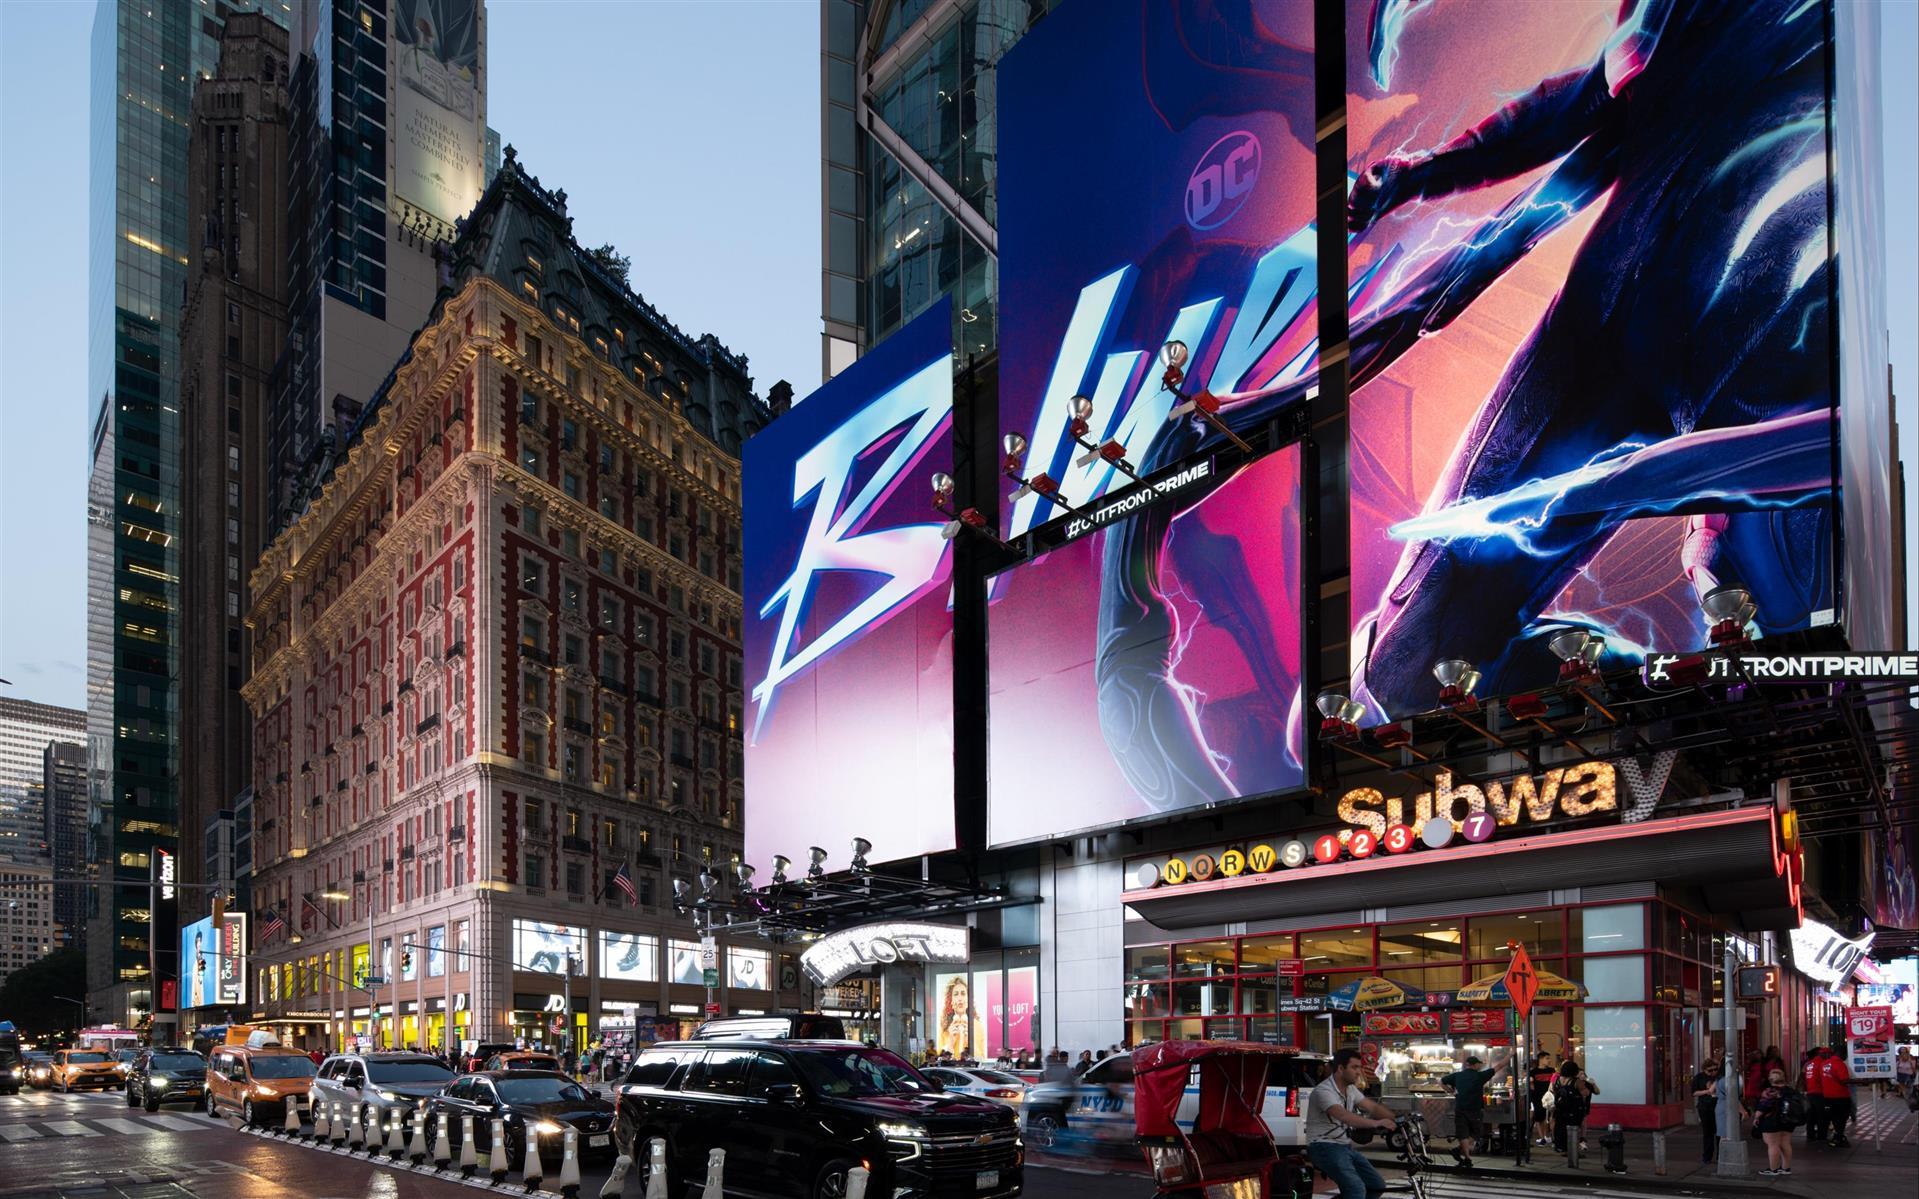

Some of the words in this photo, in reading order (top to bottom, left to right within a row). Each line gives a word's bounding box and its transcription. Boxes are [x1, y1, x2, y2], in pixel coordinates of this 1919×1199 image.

[413, 116, 463, 151] ELEMENTS
[415, 108, 462, 141] NATURAL
[404, 123, 470, 166] MASTERFULLY
[410, 136, 464, 172] COMBINED
[1191, 140, 1259, 223] DC
[1337, 751, 1678, 846] Subway
[162, 855, 174, 900] verizon
[703, 950, 713, 959] 25
[849, 934, 933, 965] LOFT
[224, 958, 233, 980] ONLY
[741, 960, 755, 974] JD
[1537, 989, 1575, 997] ABRETT
[1764, 972, 1774, 992] 2
[454, 993, 466, 1011] JD
[544, 994, 565, 1012] JD
[1012, 1003, 1029, 1014] LOFT
[1080, 1095, 1124, 1112] NYPD
